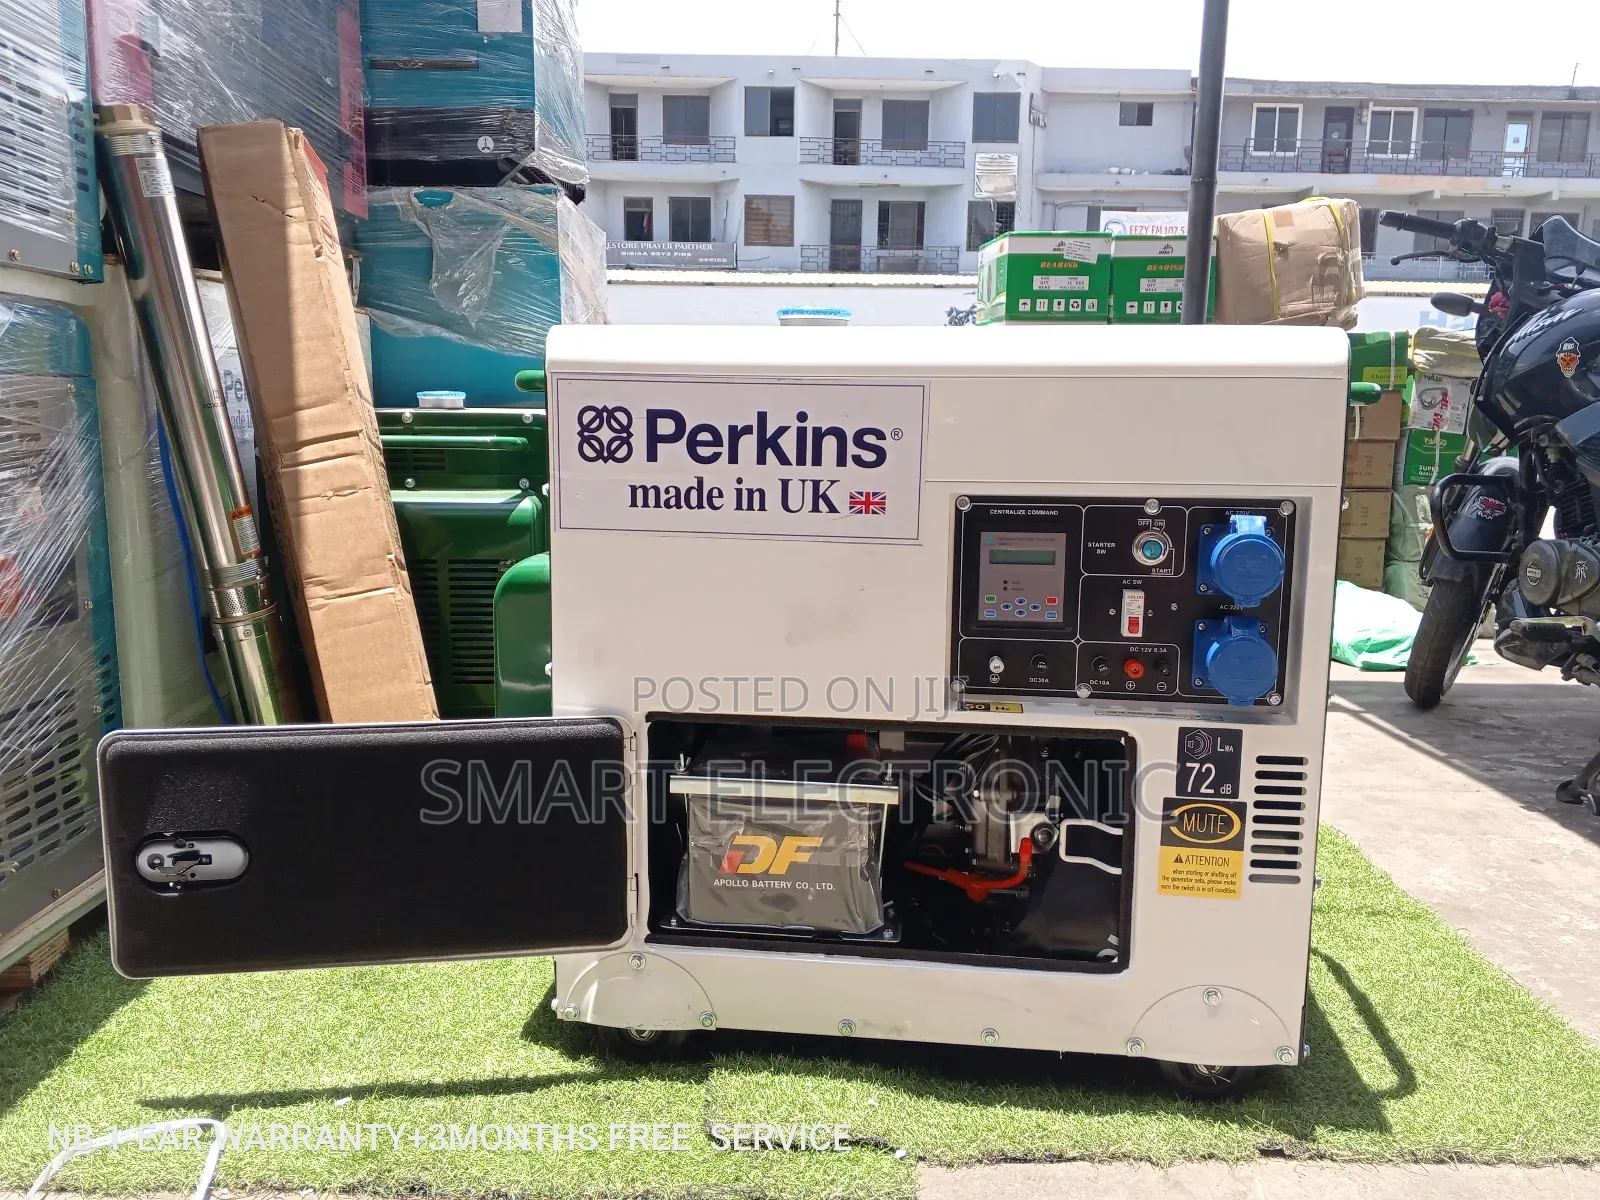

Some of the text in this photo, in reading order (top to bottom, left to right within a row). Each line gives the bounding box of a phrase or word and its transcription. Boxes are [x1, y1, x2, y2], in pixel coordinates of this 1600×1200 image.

[605, 241, 714, 251] ESTORE PRAYER PARTNER
[646, 407, 888, 469] Perkins
[628, 476, 841, 514] made in UK
[1185, 762, 1233, 796] 72 dB
[1183, 812, 1229, 836] MUTE
[1184, 854, 1231, 867] ATTENTION
[1161, 874, 1170, 882] the
[1206, 878, 1222, 886] please
[1223, 878, 1237, 886] make
[1185, 869, 1203, 877] starting
[1210, 870, 1229, 879] shutting
[1229, 871, 1237, 879] off
[713, 878, 836, 891] APOLLO BATTERY CO., LTD.
[1172, 883, 1180, 891] the
[1180, 884, 1196, 892] switch
[1214, 887, 1238, 895] condition.
